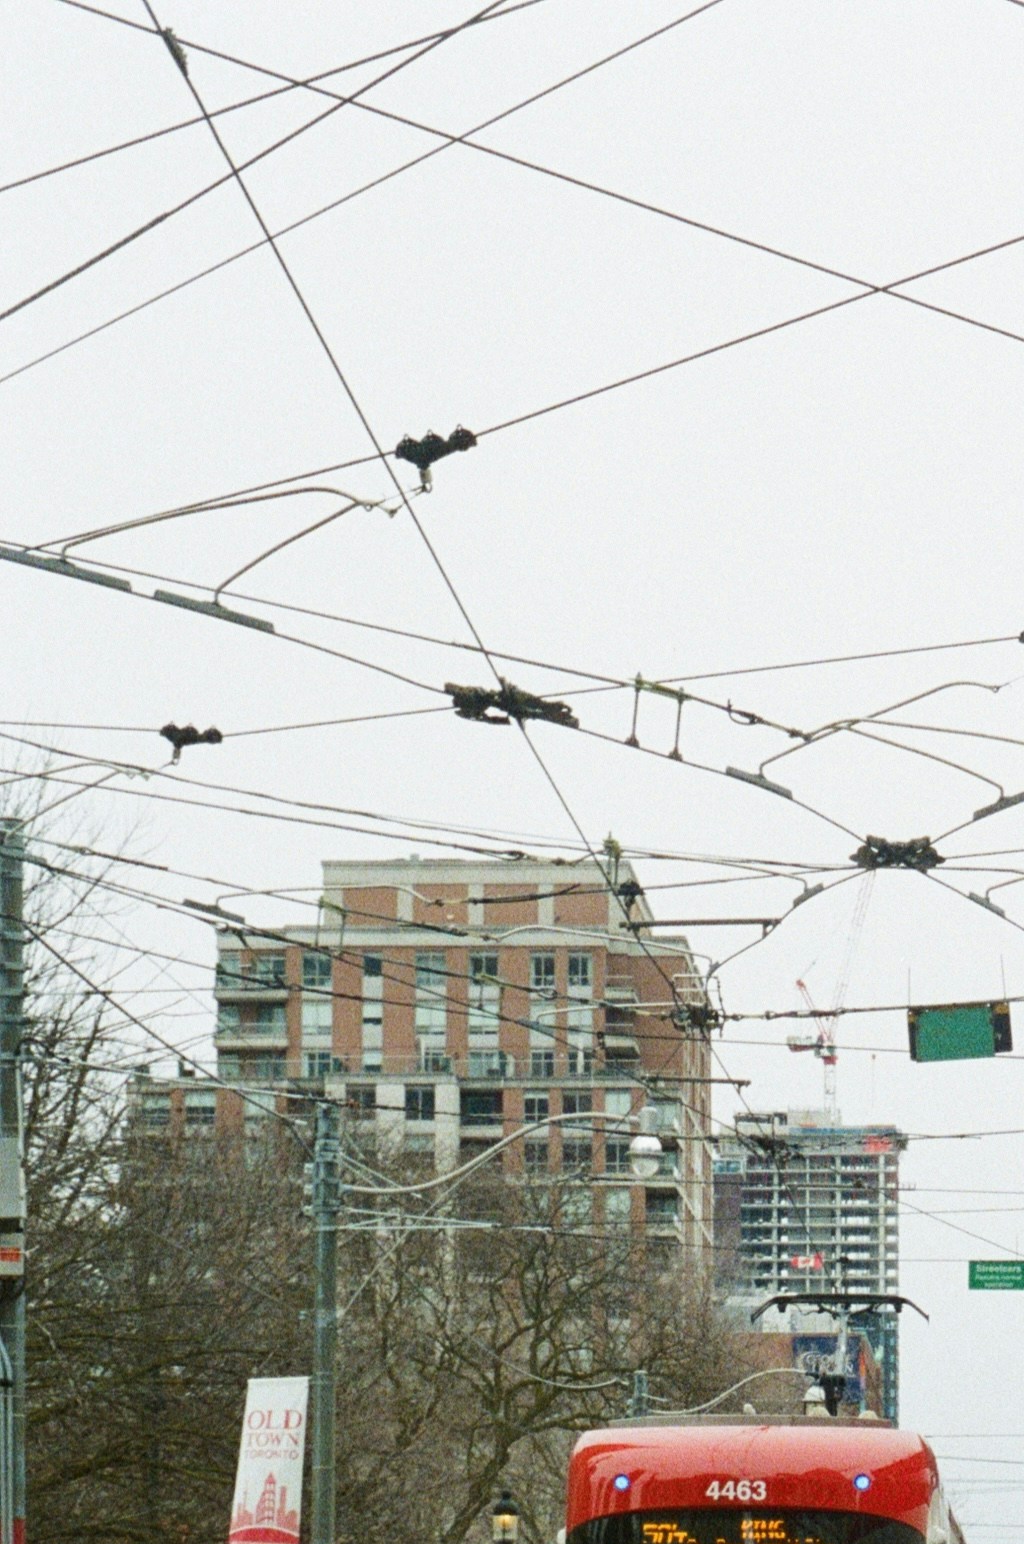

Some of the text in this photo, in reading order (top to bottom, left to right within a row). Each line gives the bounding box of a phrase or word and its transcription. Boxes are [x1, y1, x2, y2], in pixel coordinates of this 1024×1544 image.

[248, 1409, 302, 1431] OLD
[248, 1432, 300, 1447] TOWN
[244, 1449, 300, 1460] TORONTO
[705, 1480, 767, 1500] 4463
